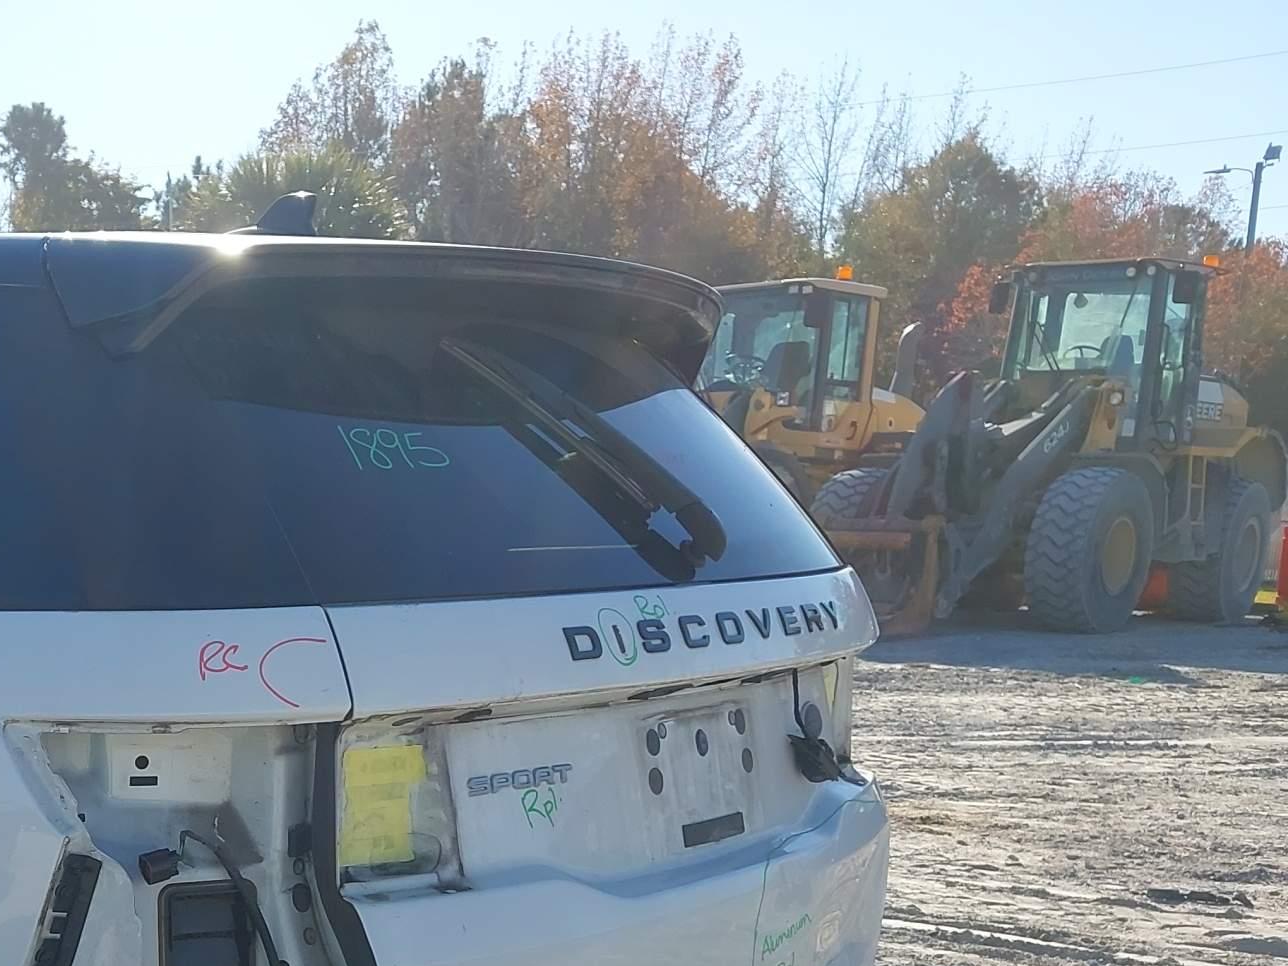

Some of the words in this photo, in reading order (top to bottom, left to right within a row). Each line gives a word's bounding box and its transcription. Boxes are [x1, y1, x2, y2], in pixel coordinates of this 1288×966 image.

[336, 424, 451, 471] 1895
[562, 600, 840, 662] DISCOVERY
[466, 763, 573, 797] SPORT
